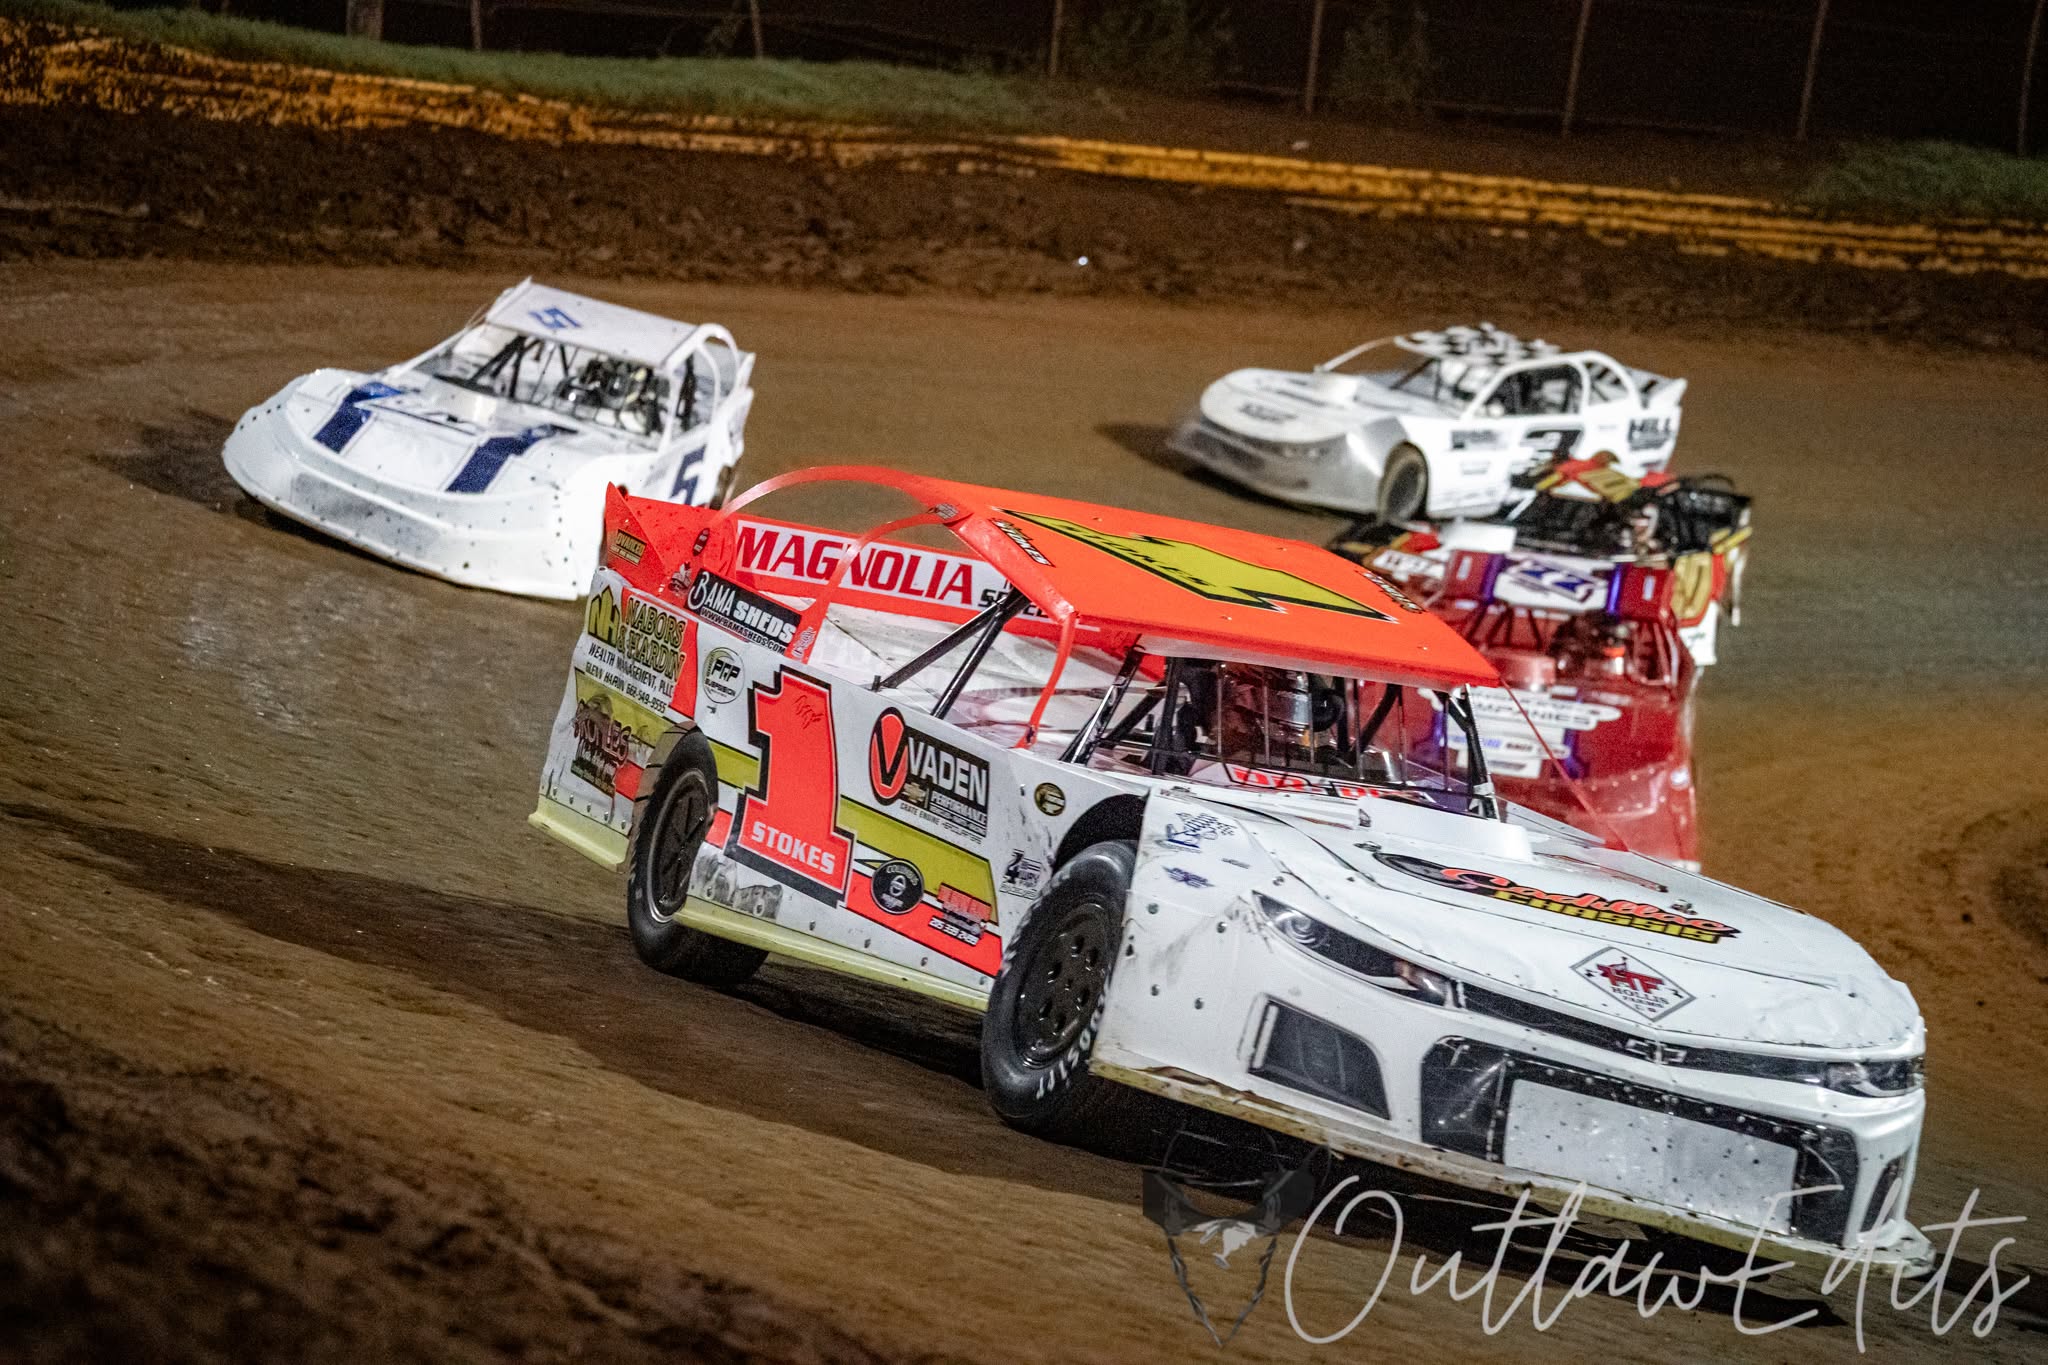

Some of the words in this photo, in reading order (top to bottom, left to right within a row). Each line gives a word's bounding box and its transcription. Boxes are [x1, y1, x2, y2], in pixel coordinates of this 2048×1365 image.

[736, 526, 973, 605] MAGNOLIA
[626, 595, 687, 649] NABORS
[687, 571, 736, 617] BAMA
[733, 600, 797, 644] SHEDS
[588, 642, 616, 666] WEALTH
[616, 625, 627, 655] &
[627, 629, 687, 683] HARDIN
[728, 664, 854, 908] 1
[908, 736, 987, 807] VADEN
[752, 820, 836, 875] STOKES
[1441, 867, 1737, 933] Cadillac
[1494, 890, 1724, 943] CHASSIS
[1611, 986, 1669, 1005] HOLLIS
